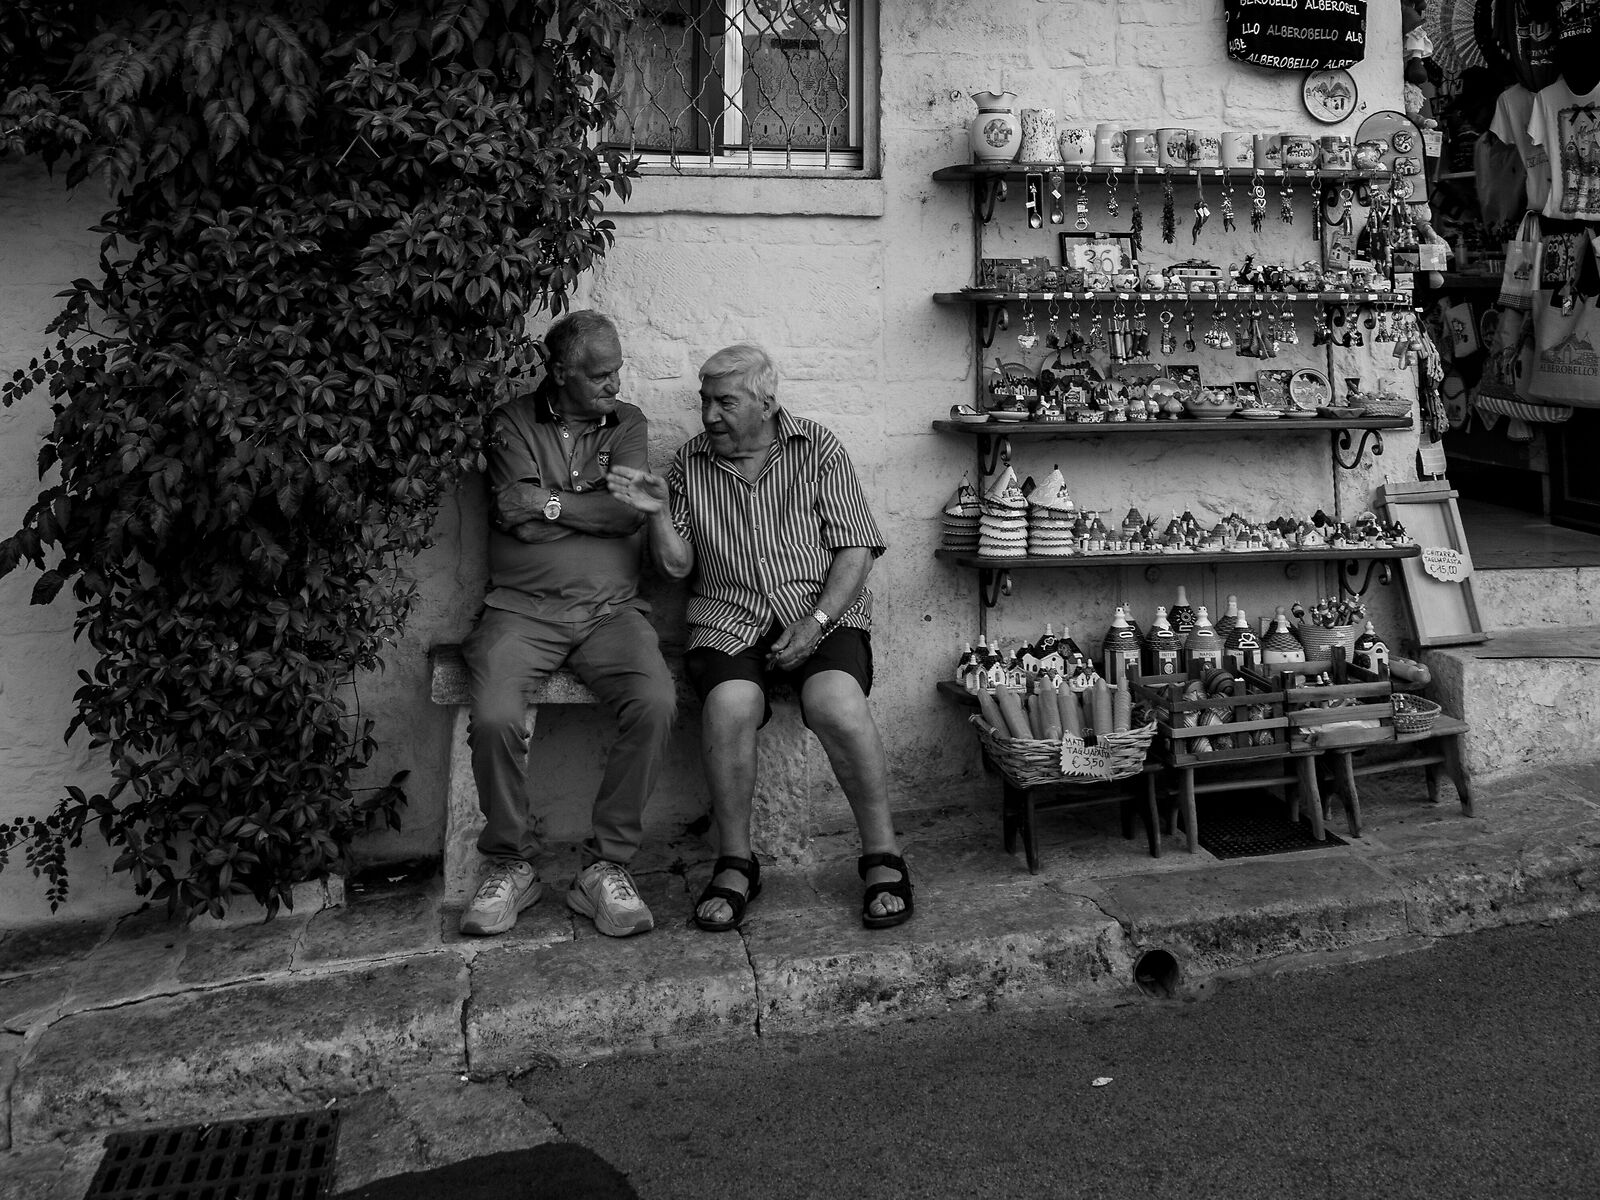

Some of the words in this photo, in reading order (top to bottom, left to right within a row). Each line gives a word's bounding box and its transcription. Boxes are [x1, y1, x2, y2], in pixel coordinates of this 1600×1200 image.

[1305, 0, 1360, 15] ALBEROBEL
[1242, 22, 1260, 35] LLO
[1266, 24, 1339, 41] ALBEROBELLO
[1345, 31, 1363, 44] ALB
[1246, 53, 1319, 69] ALBEROBELLO
[1426, 550, 1457, 558] CHITARRA
